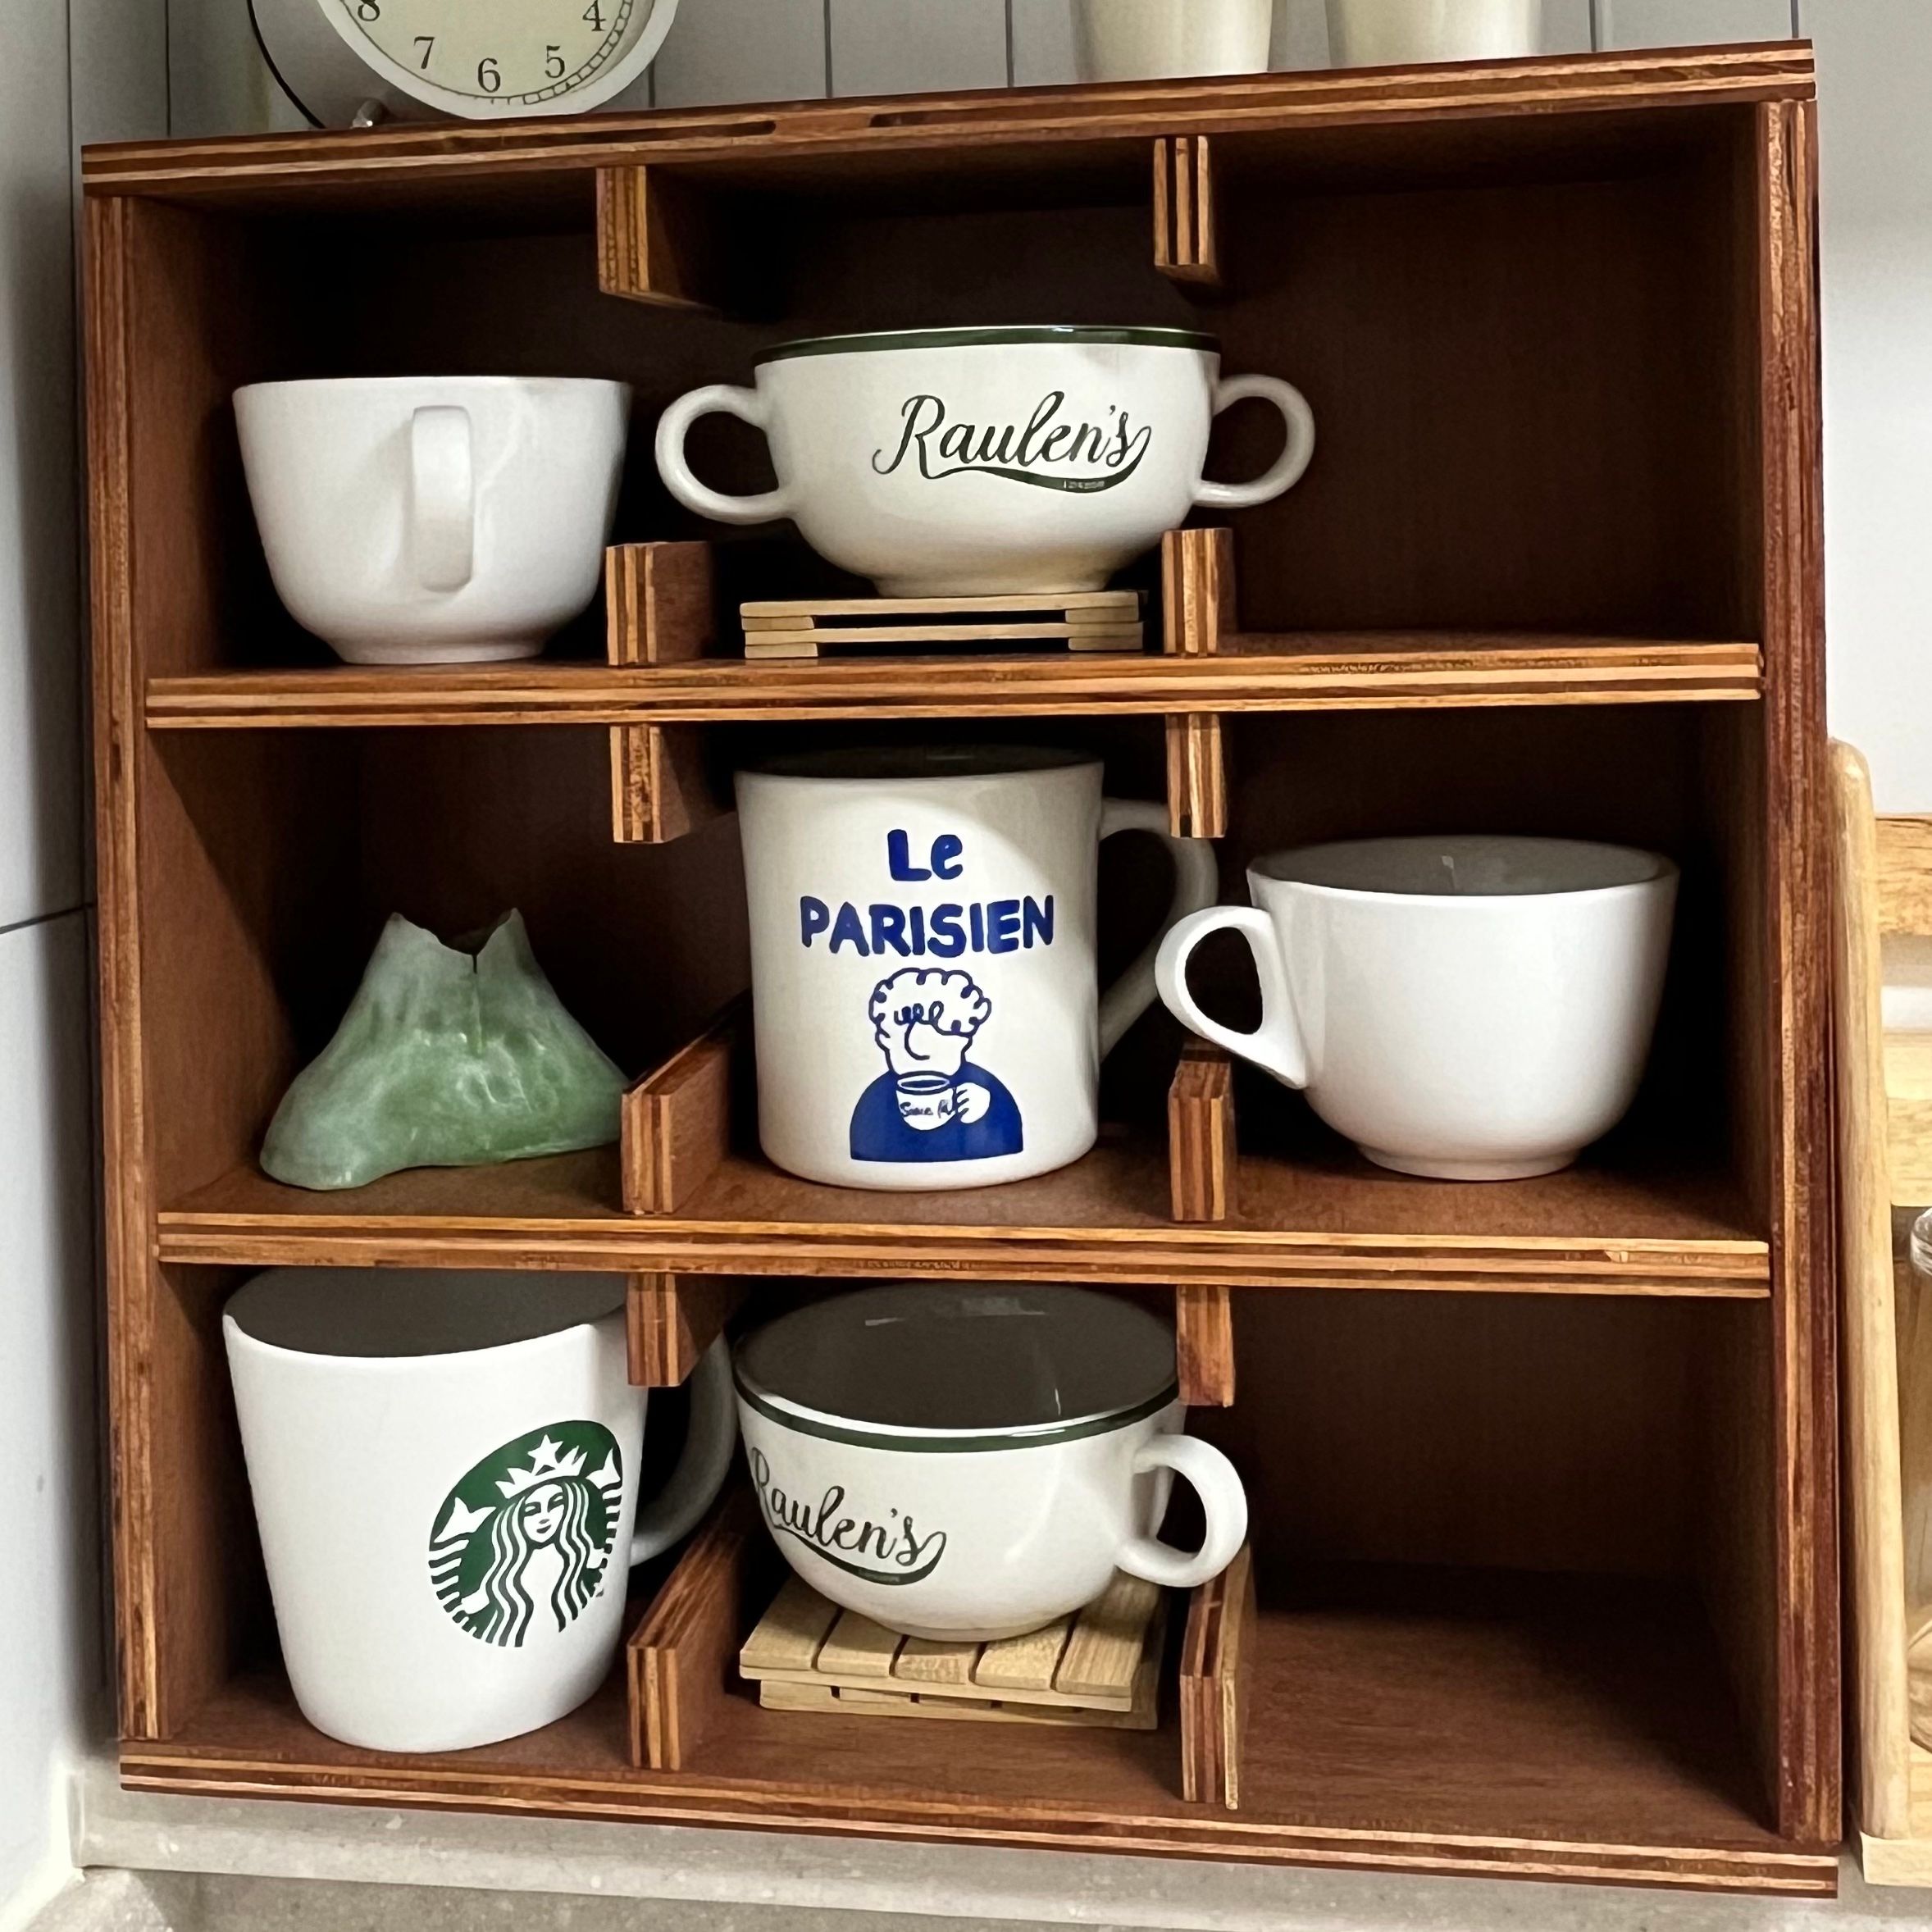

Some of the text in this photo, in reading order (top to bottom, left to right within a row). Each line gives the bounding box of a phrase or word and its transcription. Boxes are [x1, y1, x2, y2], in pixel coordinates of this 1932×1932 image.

[358, 0, 380, 21] 8
[582, 0, 607, 31] 4
[413, 36, 435, 70] 7
[545, 45, 566, 79] 5
[477, 57, 501, 93] 6
[872, 390, 1151, 493] Raulen's
[886, 828, 964, 882] Le
[800, 895, 1054, 959] PARISIEN
